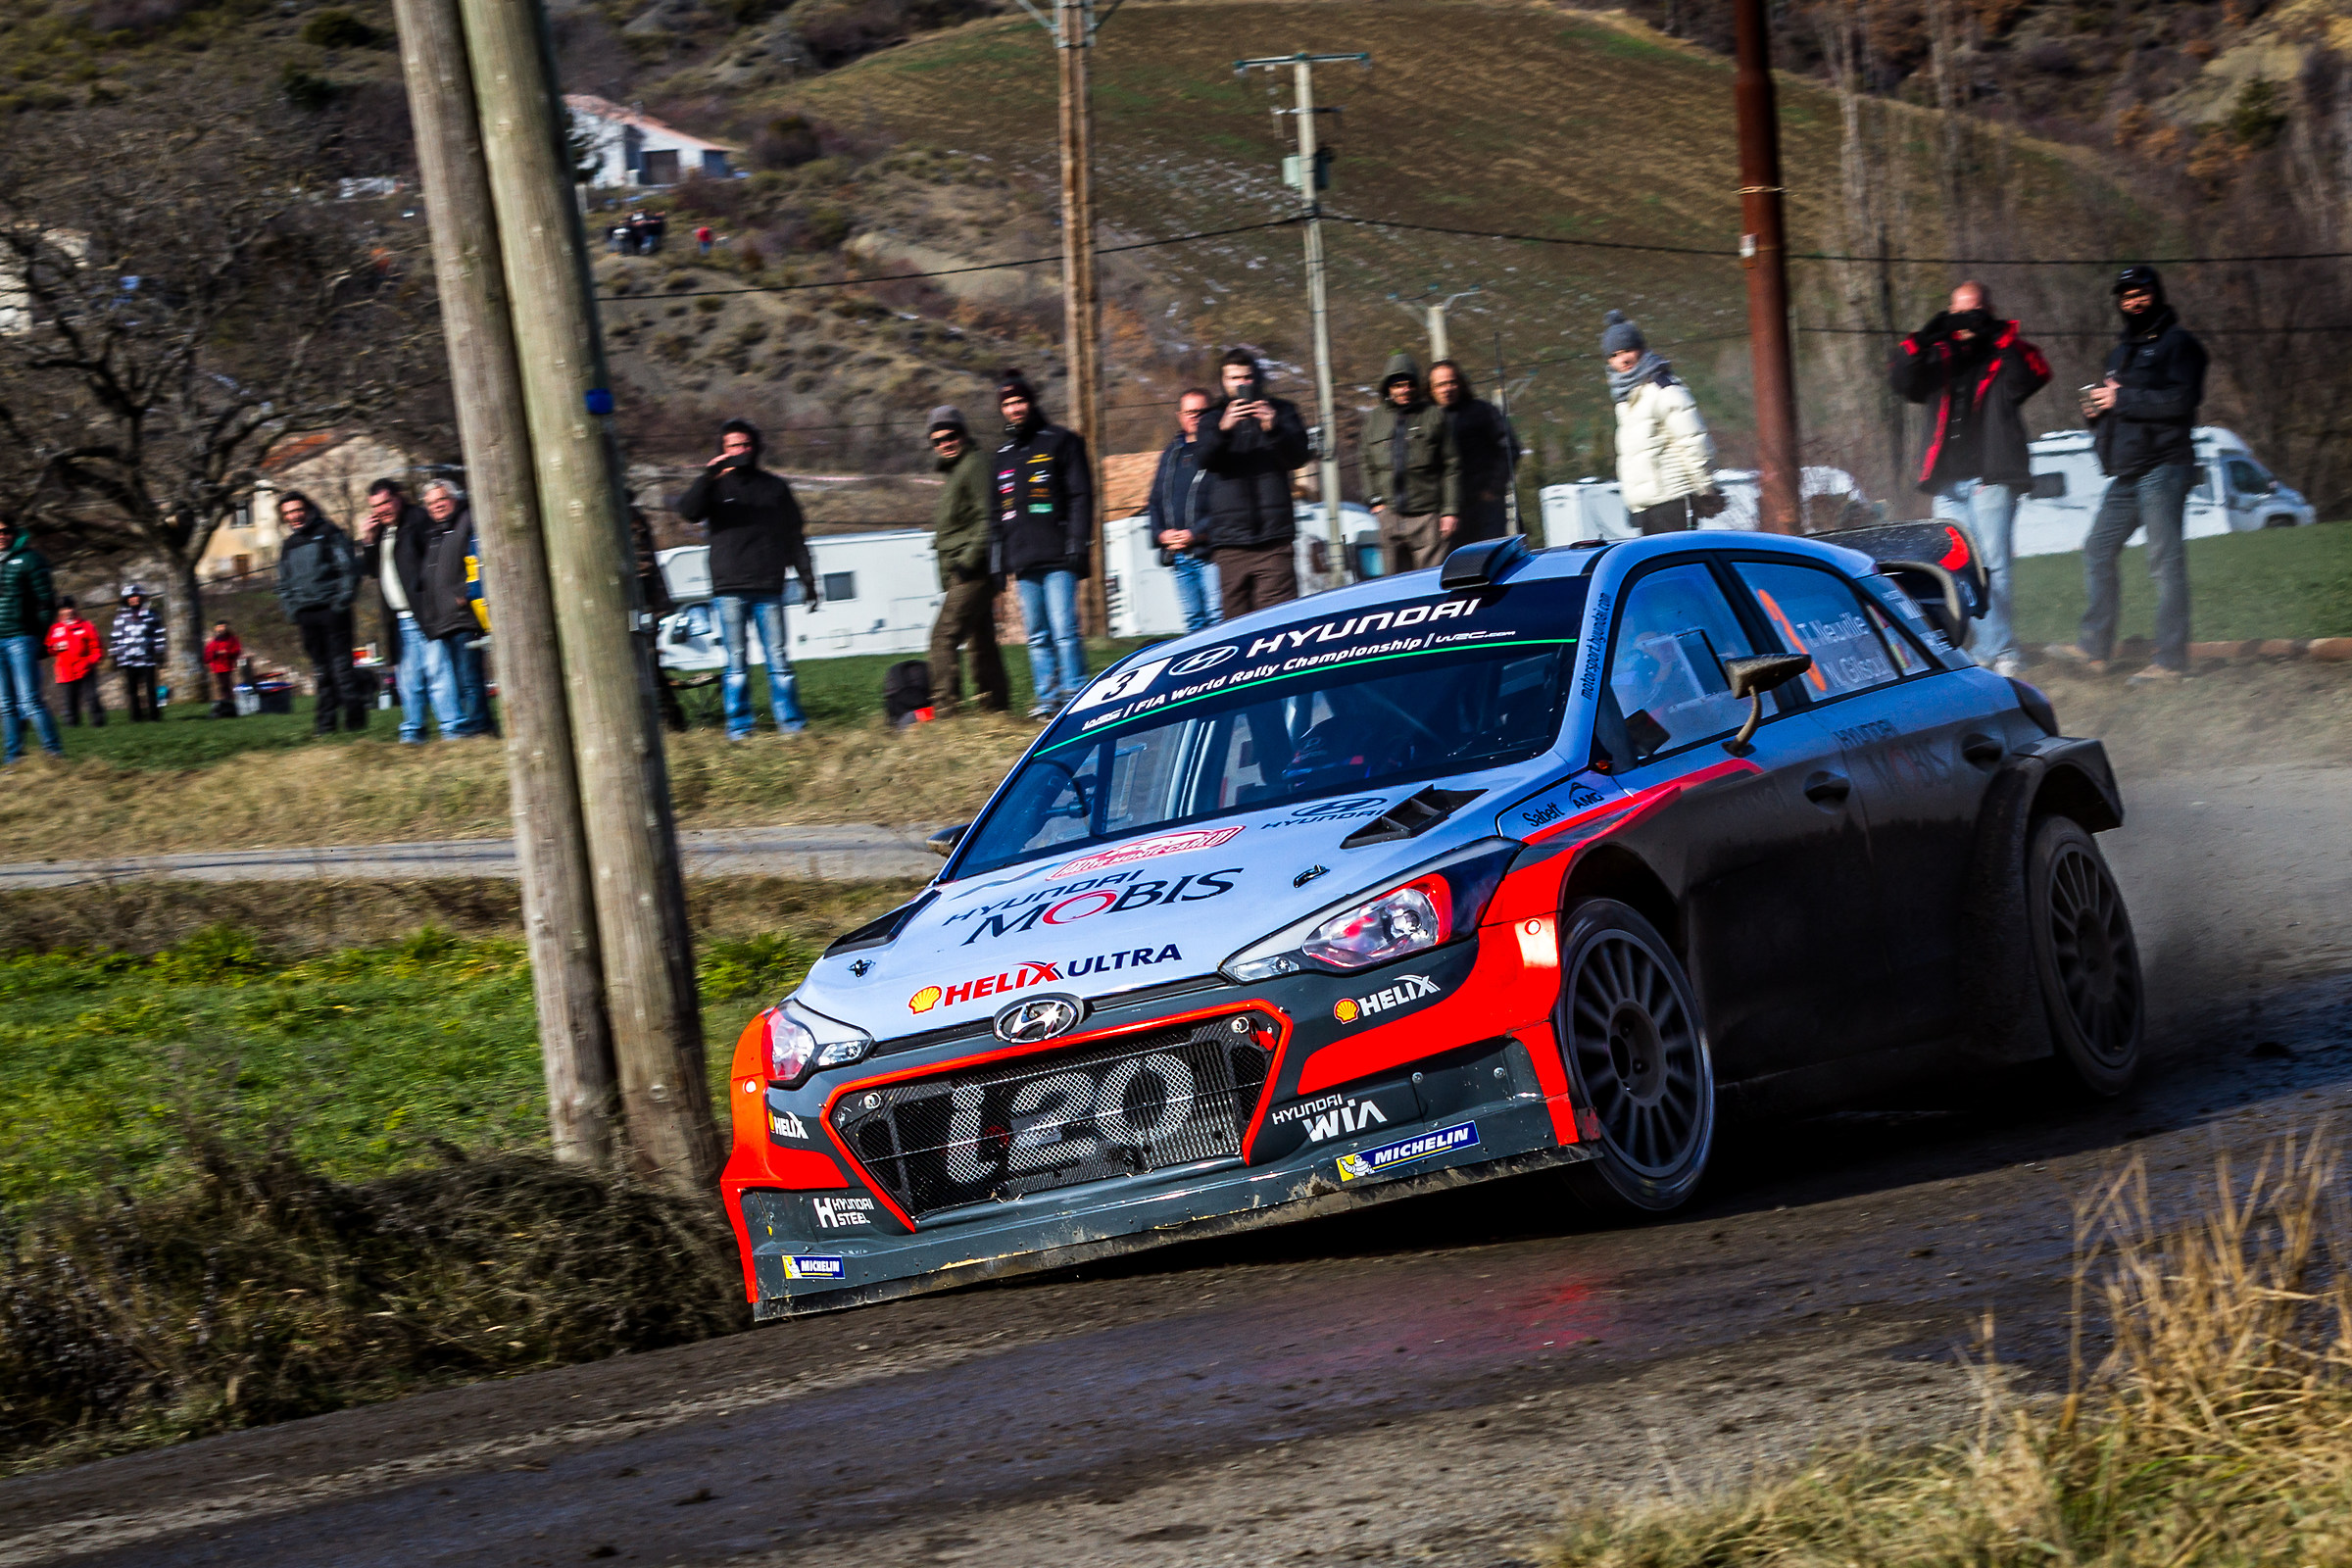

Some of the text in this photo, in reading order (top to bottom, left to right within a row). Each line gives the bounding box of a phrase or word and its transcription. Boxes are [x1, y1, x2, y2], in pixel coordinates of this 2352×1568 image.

[1246, 597, 1482, 659] HYUNDAI
[1580, 592, 1611, 701] motorsport.hyundai.com
[1101, 668, 1140, 702] 3
[1134, 697, 1166, 713] FIA
[1170, 674, 1227, 701] World
[1228, 662, 1281, 685] Rally
[1282, 637, 1423, 671] Championship
[1260, 808, 1386, 830] HYUNDAI
[1522, 802, 1566, 827] Sabelt
[942, 868, 1145, 927] HYUNDAI
[960, 866, 1245, 947] MOBIS
[944, 943, 1183, 1007] HELIX ULTRA
[1357, 974, 1442, 1017] HELIX
[772, 1110, 809, 1140] HELIX
[1271, 1094, 1344, 1125] HYUNDAI
[1374, 1127, 1469, 1165] MICHELIN
[833, 1197, 875, 1212] HYUNDAI
[837, 1210, 871, 1226] STEEL
[801, 1258, 841, 1273] MICHELIN
